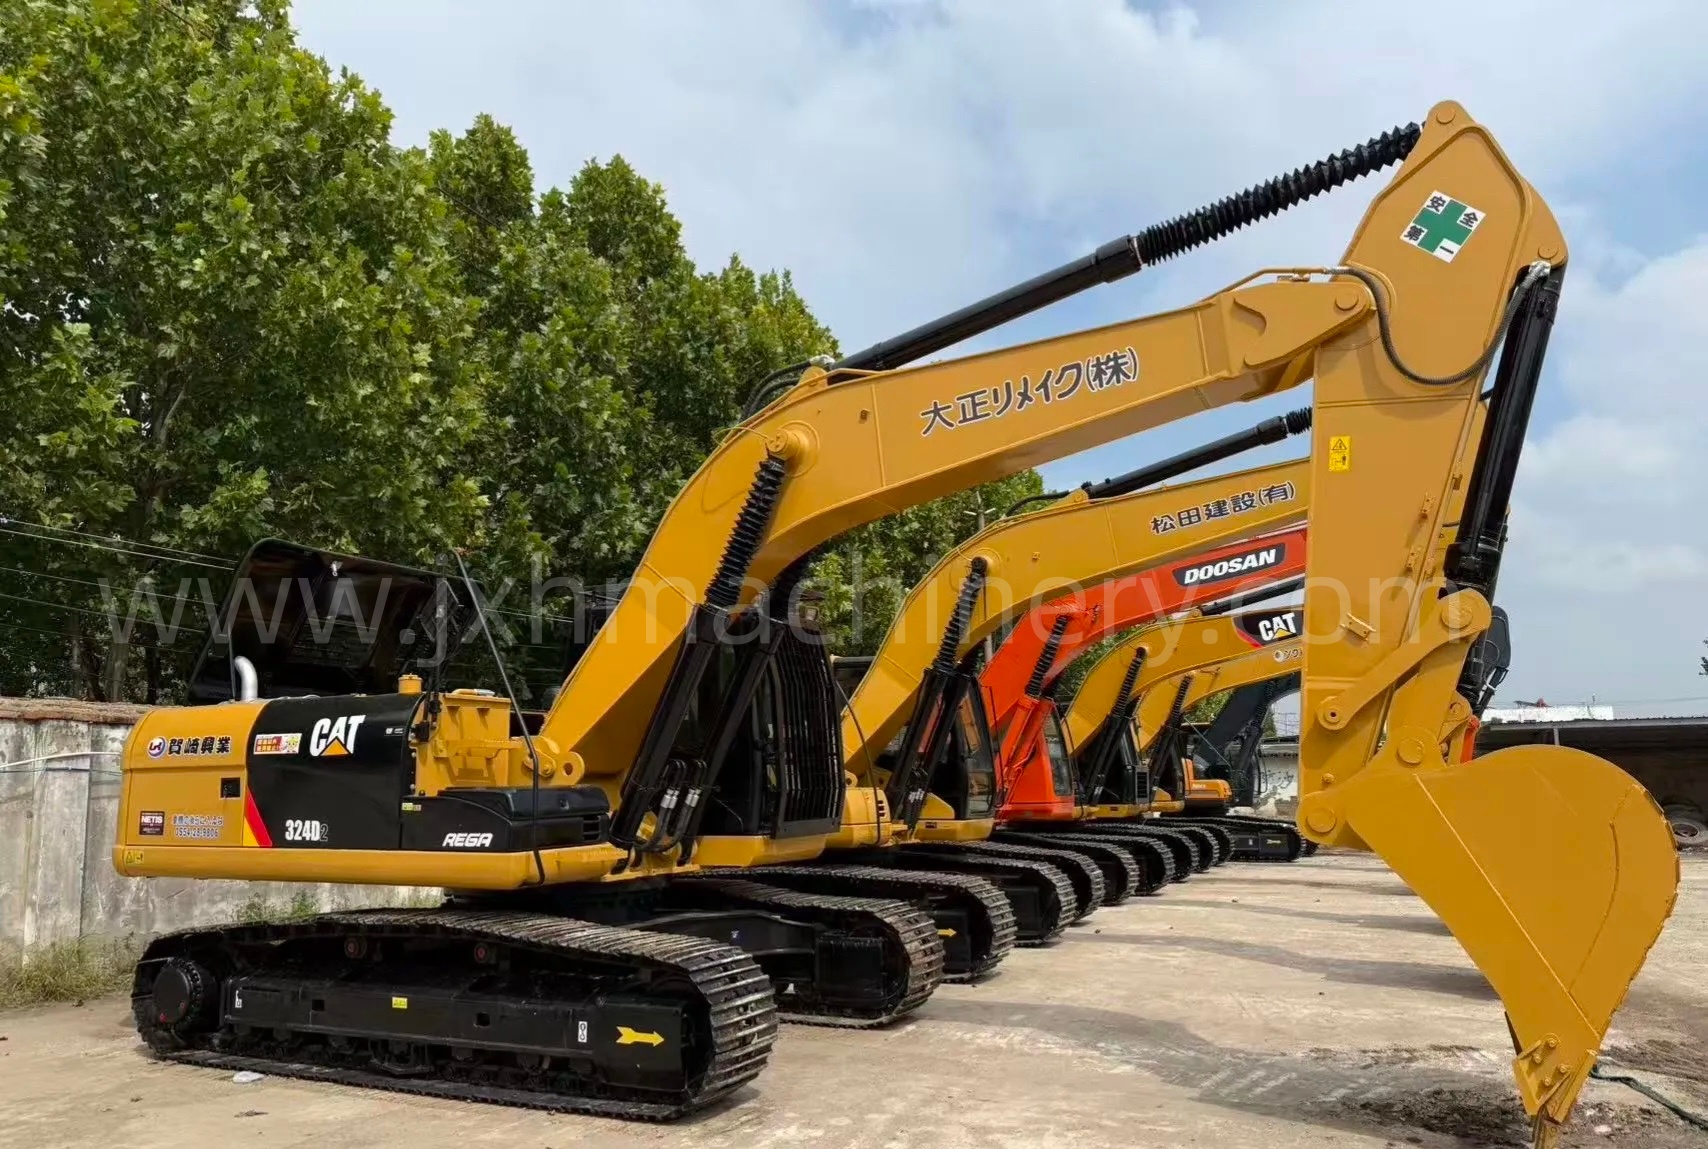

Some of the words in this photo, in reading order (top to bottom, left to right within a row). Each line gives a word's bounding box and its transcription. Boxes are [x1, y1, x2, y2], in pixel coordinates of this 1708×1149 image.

[921, 347, 1138, 436] 大正リメイク(株)
[1150, 481, 1295, 534] 松田建設(有)
[1184, 548, 1277, 584] DOOSAN
[1258, 612, 1297, 641] CAT
[310, 715, 366, 757] CAT
[141, 815, 163, 824] NETIS
[285, 819, 328, 842] 324D2
[442, 832, 494, 847] REGA
